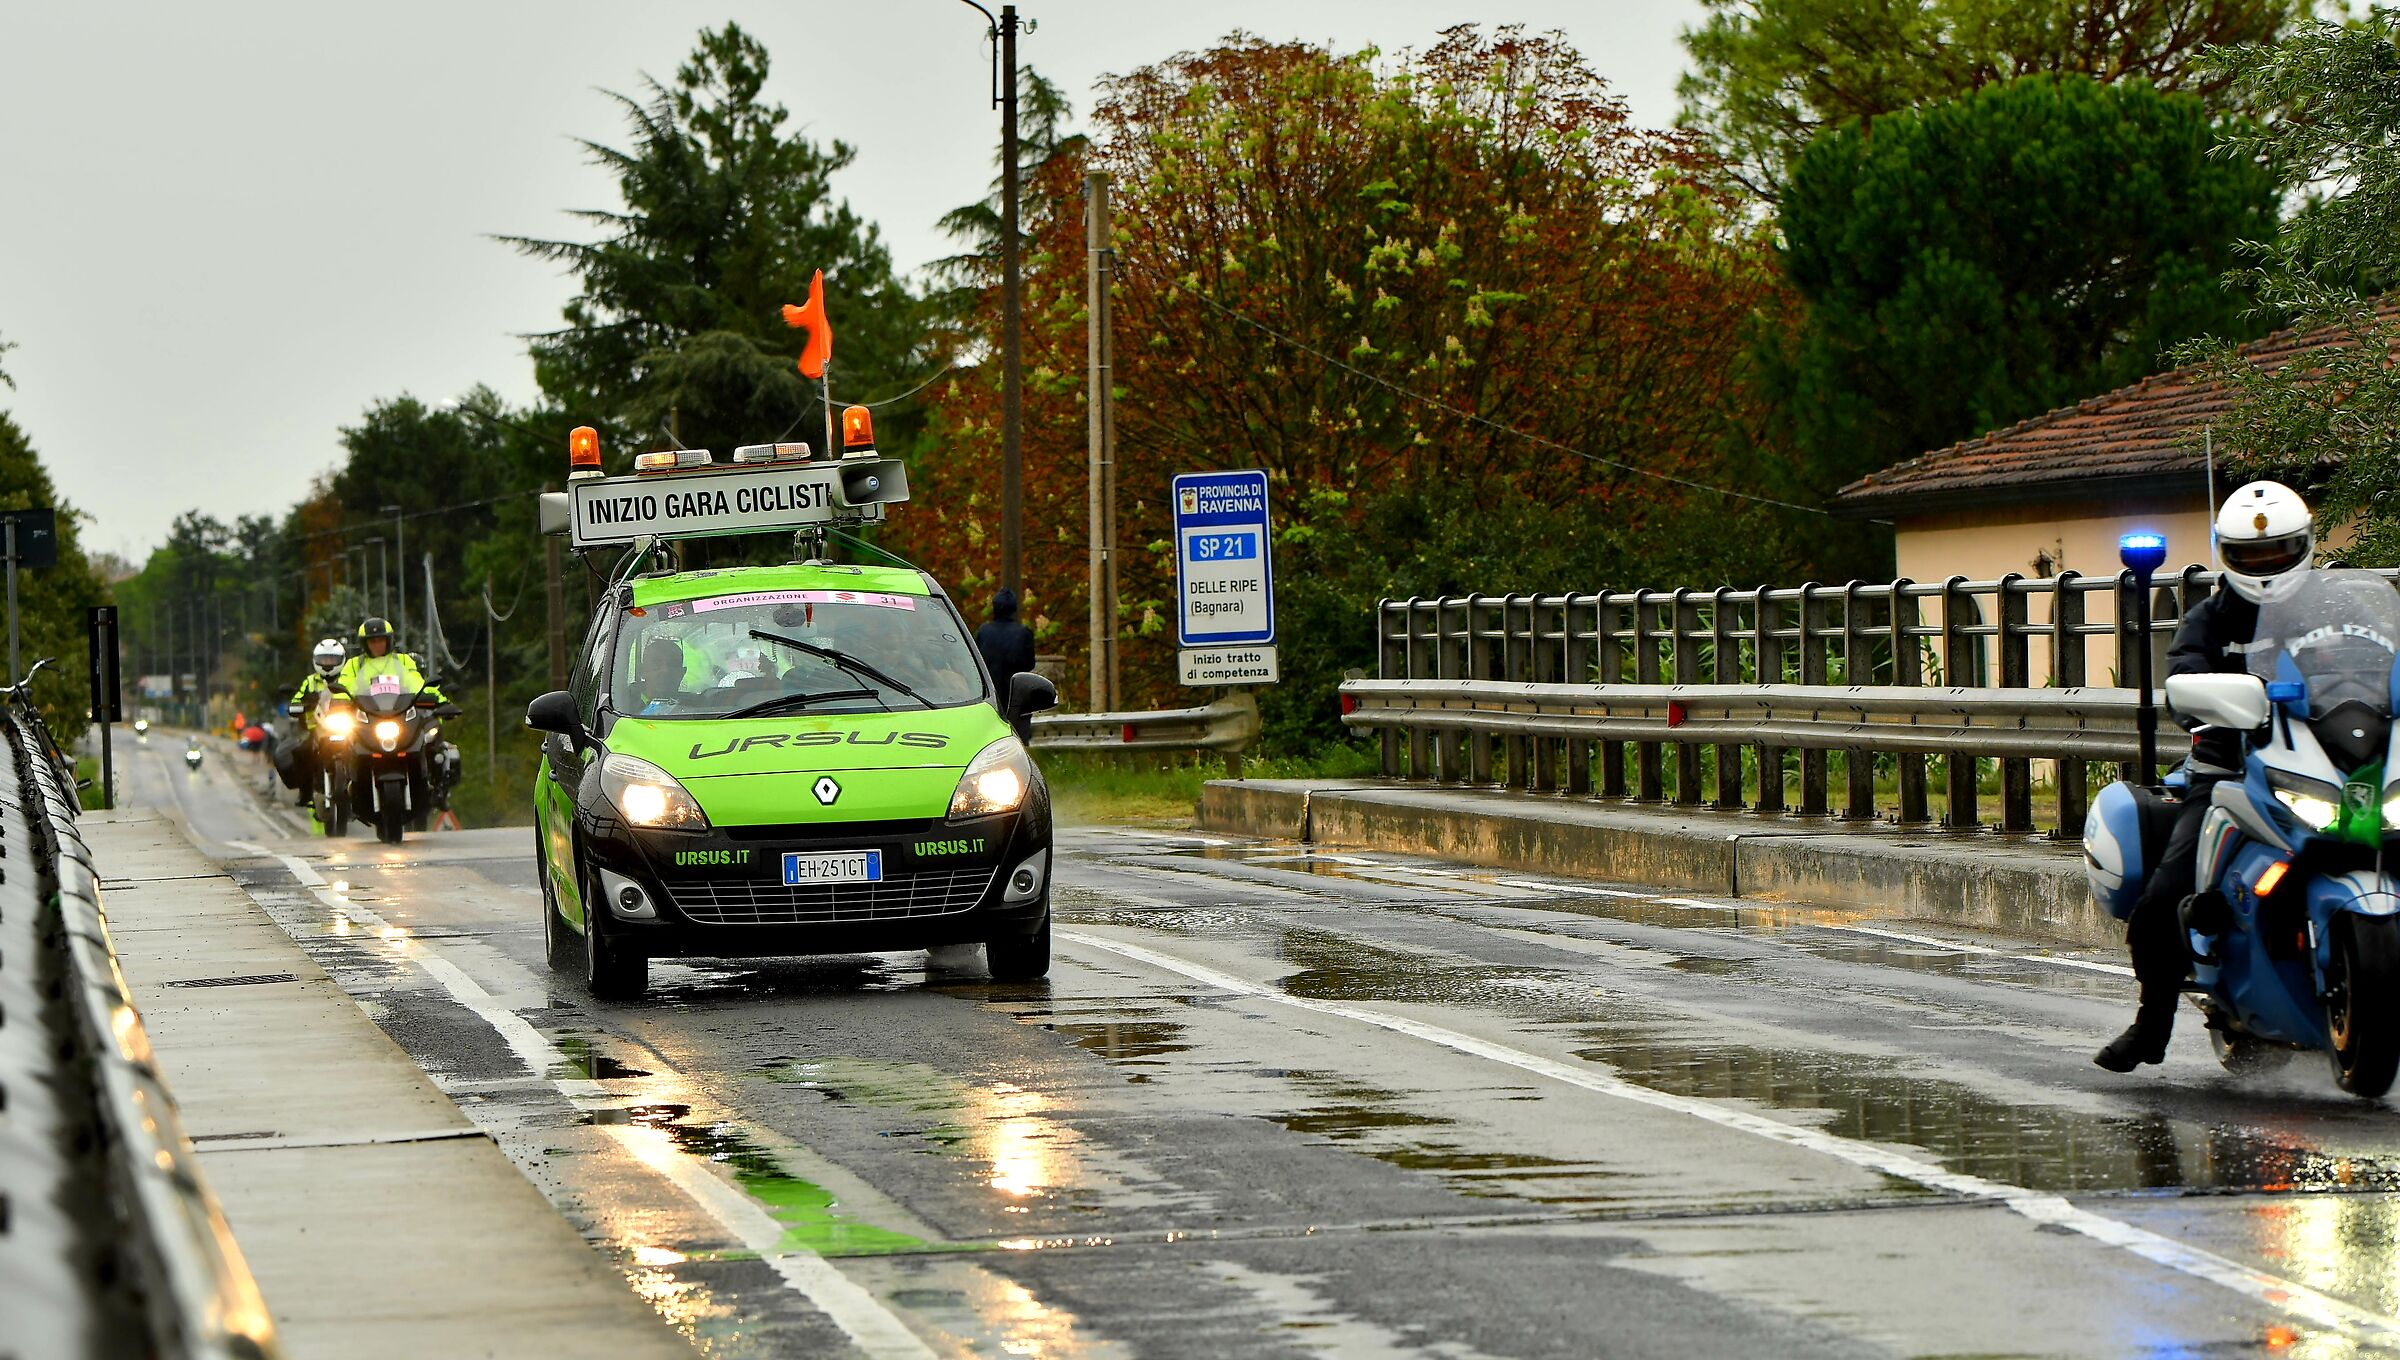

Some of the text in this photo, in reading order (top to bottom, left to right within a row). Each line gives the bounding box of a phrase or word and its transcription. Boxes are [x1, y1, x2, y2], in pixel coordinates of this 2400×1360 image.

[1199, 483, 1262, 499] PROVINCIA DI
[588, 482, 831, 525] INIZIO GARA CICLISTI
[1200, 498, 1263, 514] RAVENNA
[1199, 536, 1243, 558] SP 21
[1190, 579, 1258, 594] DELLE RIPE
[713, 593, 809, 606] ORGANIZZAZIONE
[880, 596, 897, 605] 31
[1190, 599, 1244, 617] (Bagnara)
[2288, 624, 2395, 658] POLIZIA
[1193, 652, 1261, 665] inizio tratto
[1187, 667, 1269, 680] di competenza
[688, 731, 951, 760] URSUS
[914, 838, 985, 857] URSUS.IT
[675, 850, 750, 866] URSUS.IT
